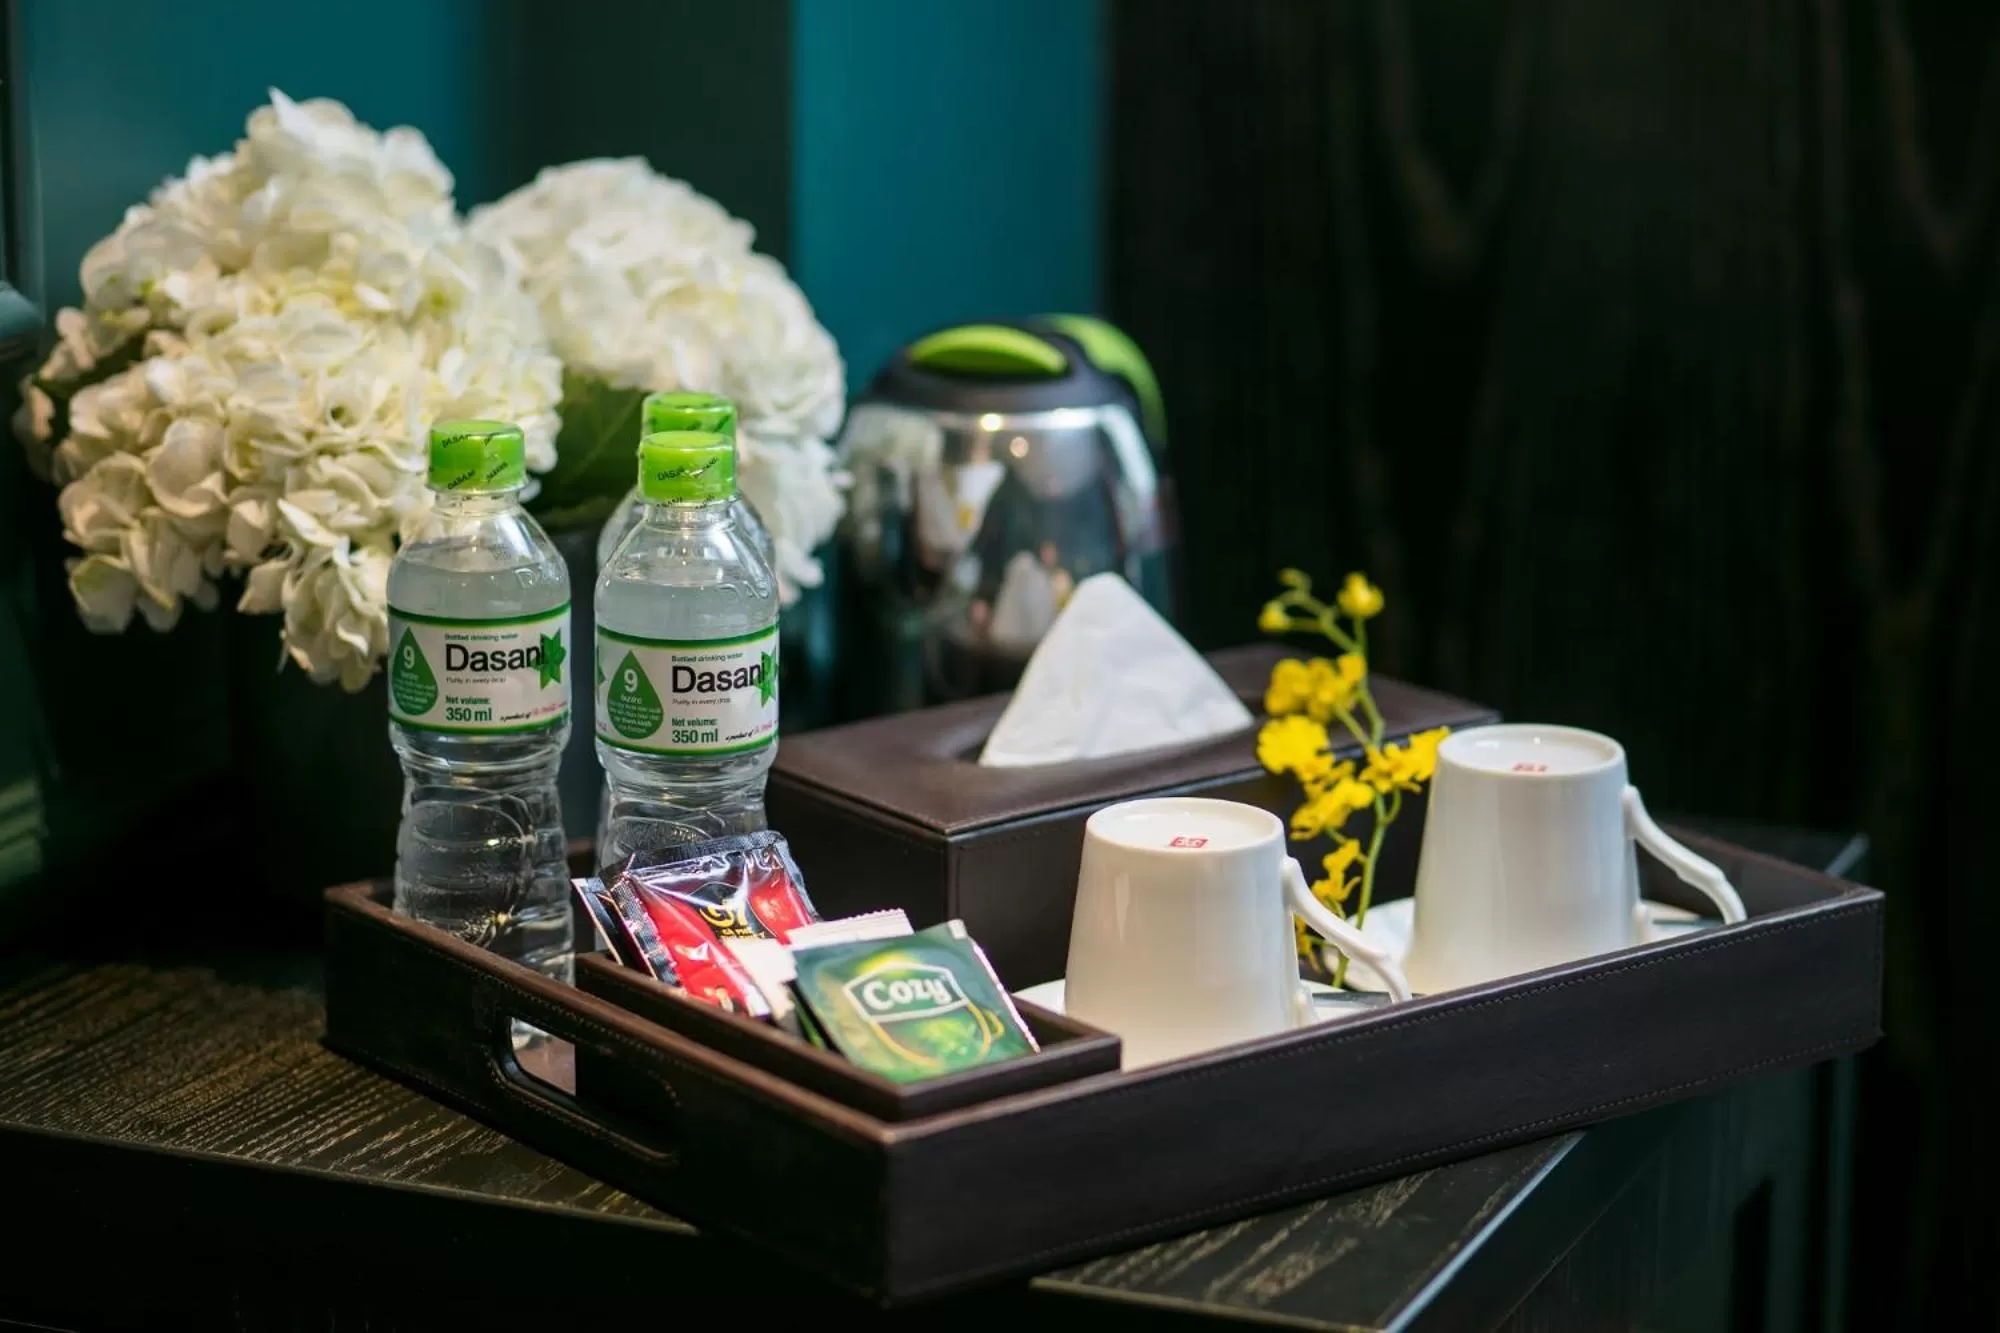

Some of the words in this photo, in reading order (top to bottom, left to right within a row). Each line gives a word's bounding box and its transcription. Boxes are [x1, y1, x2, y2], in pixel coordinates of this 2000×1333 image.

[403, 645, 415, 669] 9
[446, 635, 545, 673] Dasani
[623, 668, 638, 693] 9
[672, 654, 765, 693] Dasani
[445, 695, 459, 705] Net
[446, 707, 471, 721] 350
[474, 707, 492, 721] ml
[671, 717, 685, 727] Net
[671, 729, 698, 744] 350
[701, 728, 718, 744] ml
[862, 978, 952, 1011] Cozy
